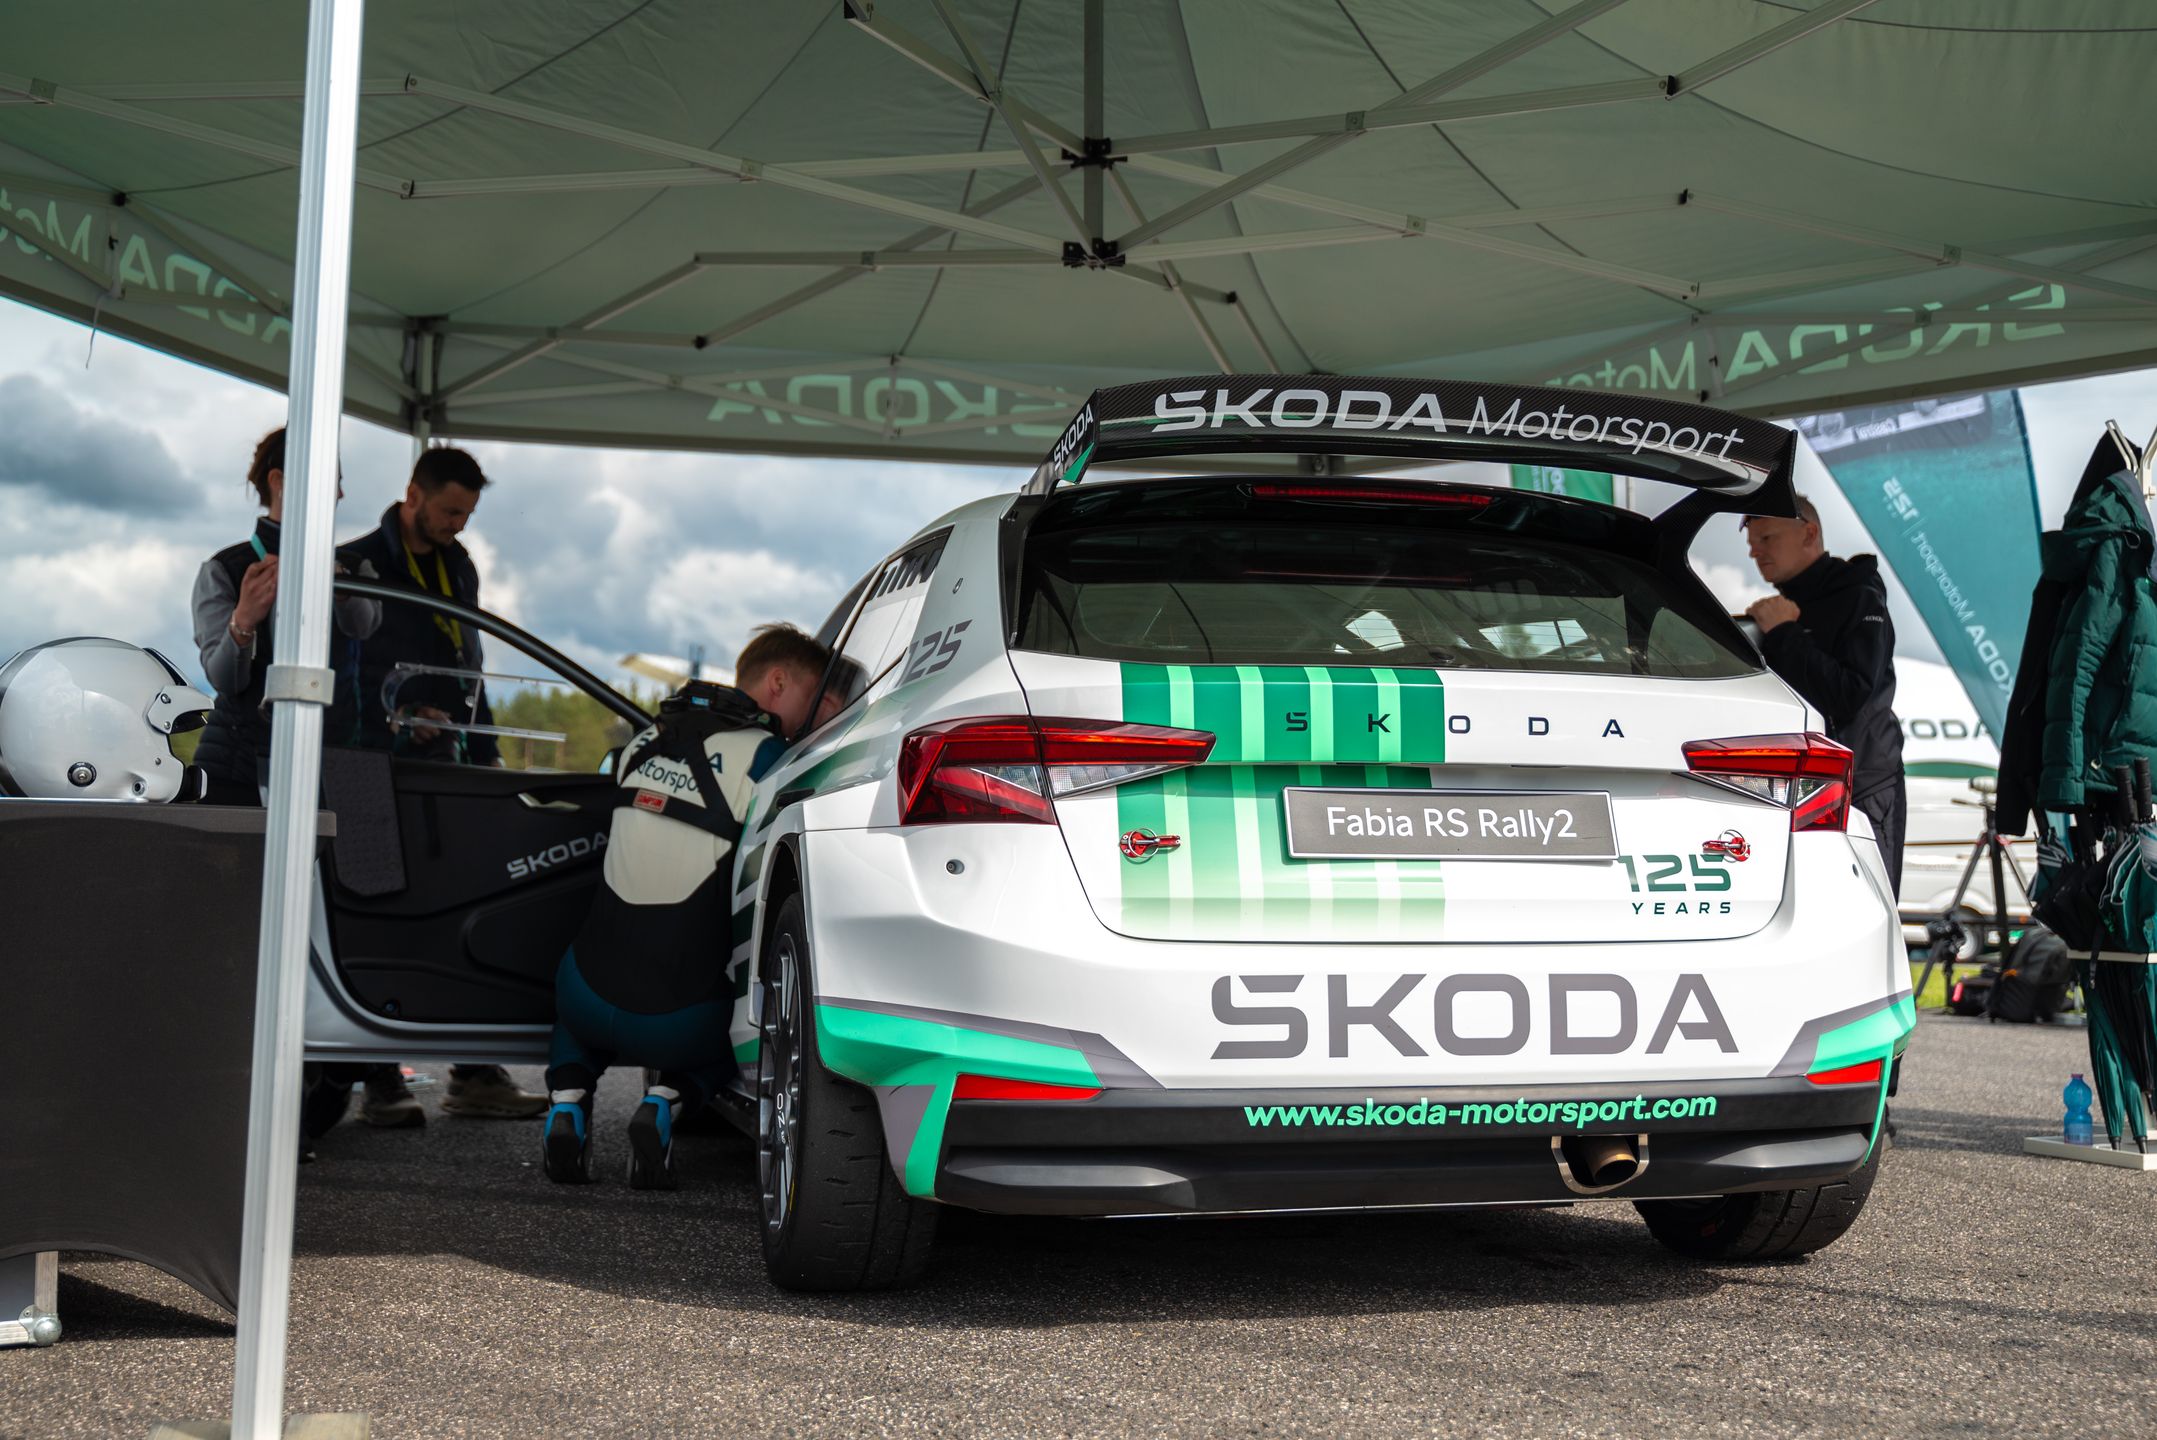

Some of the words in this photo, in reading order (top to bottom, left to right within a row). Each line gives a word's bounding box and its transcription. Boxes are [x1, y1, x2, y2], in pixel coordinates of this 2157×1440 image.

[1466, 396, 1744, 462] Motorsport
[895, 619, 973, 689] 125
[637, 757, 701, 793] otorspo
[1327, 806, 1413, 836] Fabia
[1423, 808, 1469, 837] RS
[1478, 809, 1577, 845] Rally2
[1618, 854, 1732, 892] 125
[1632, 902, 1731, 915] YEARS
[1244, 1094, 1717, 1130] www.skoda-motorsport.com
